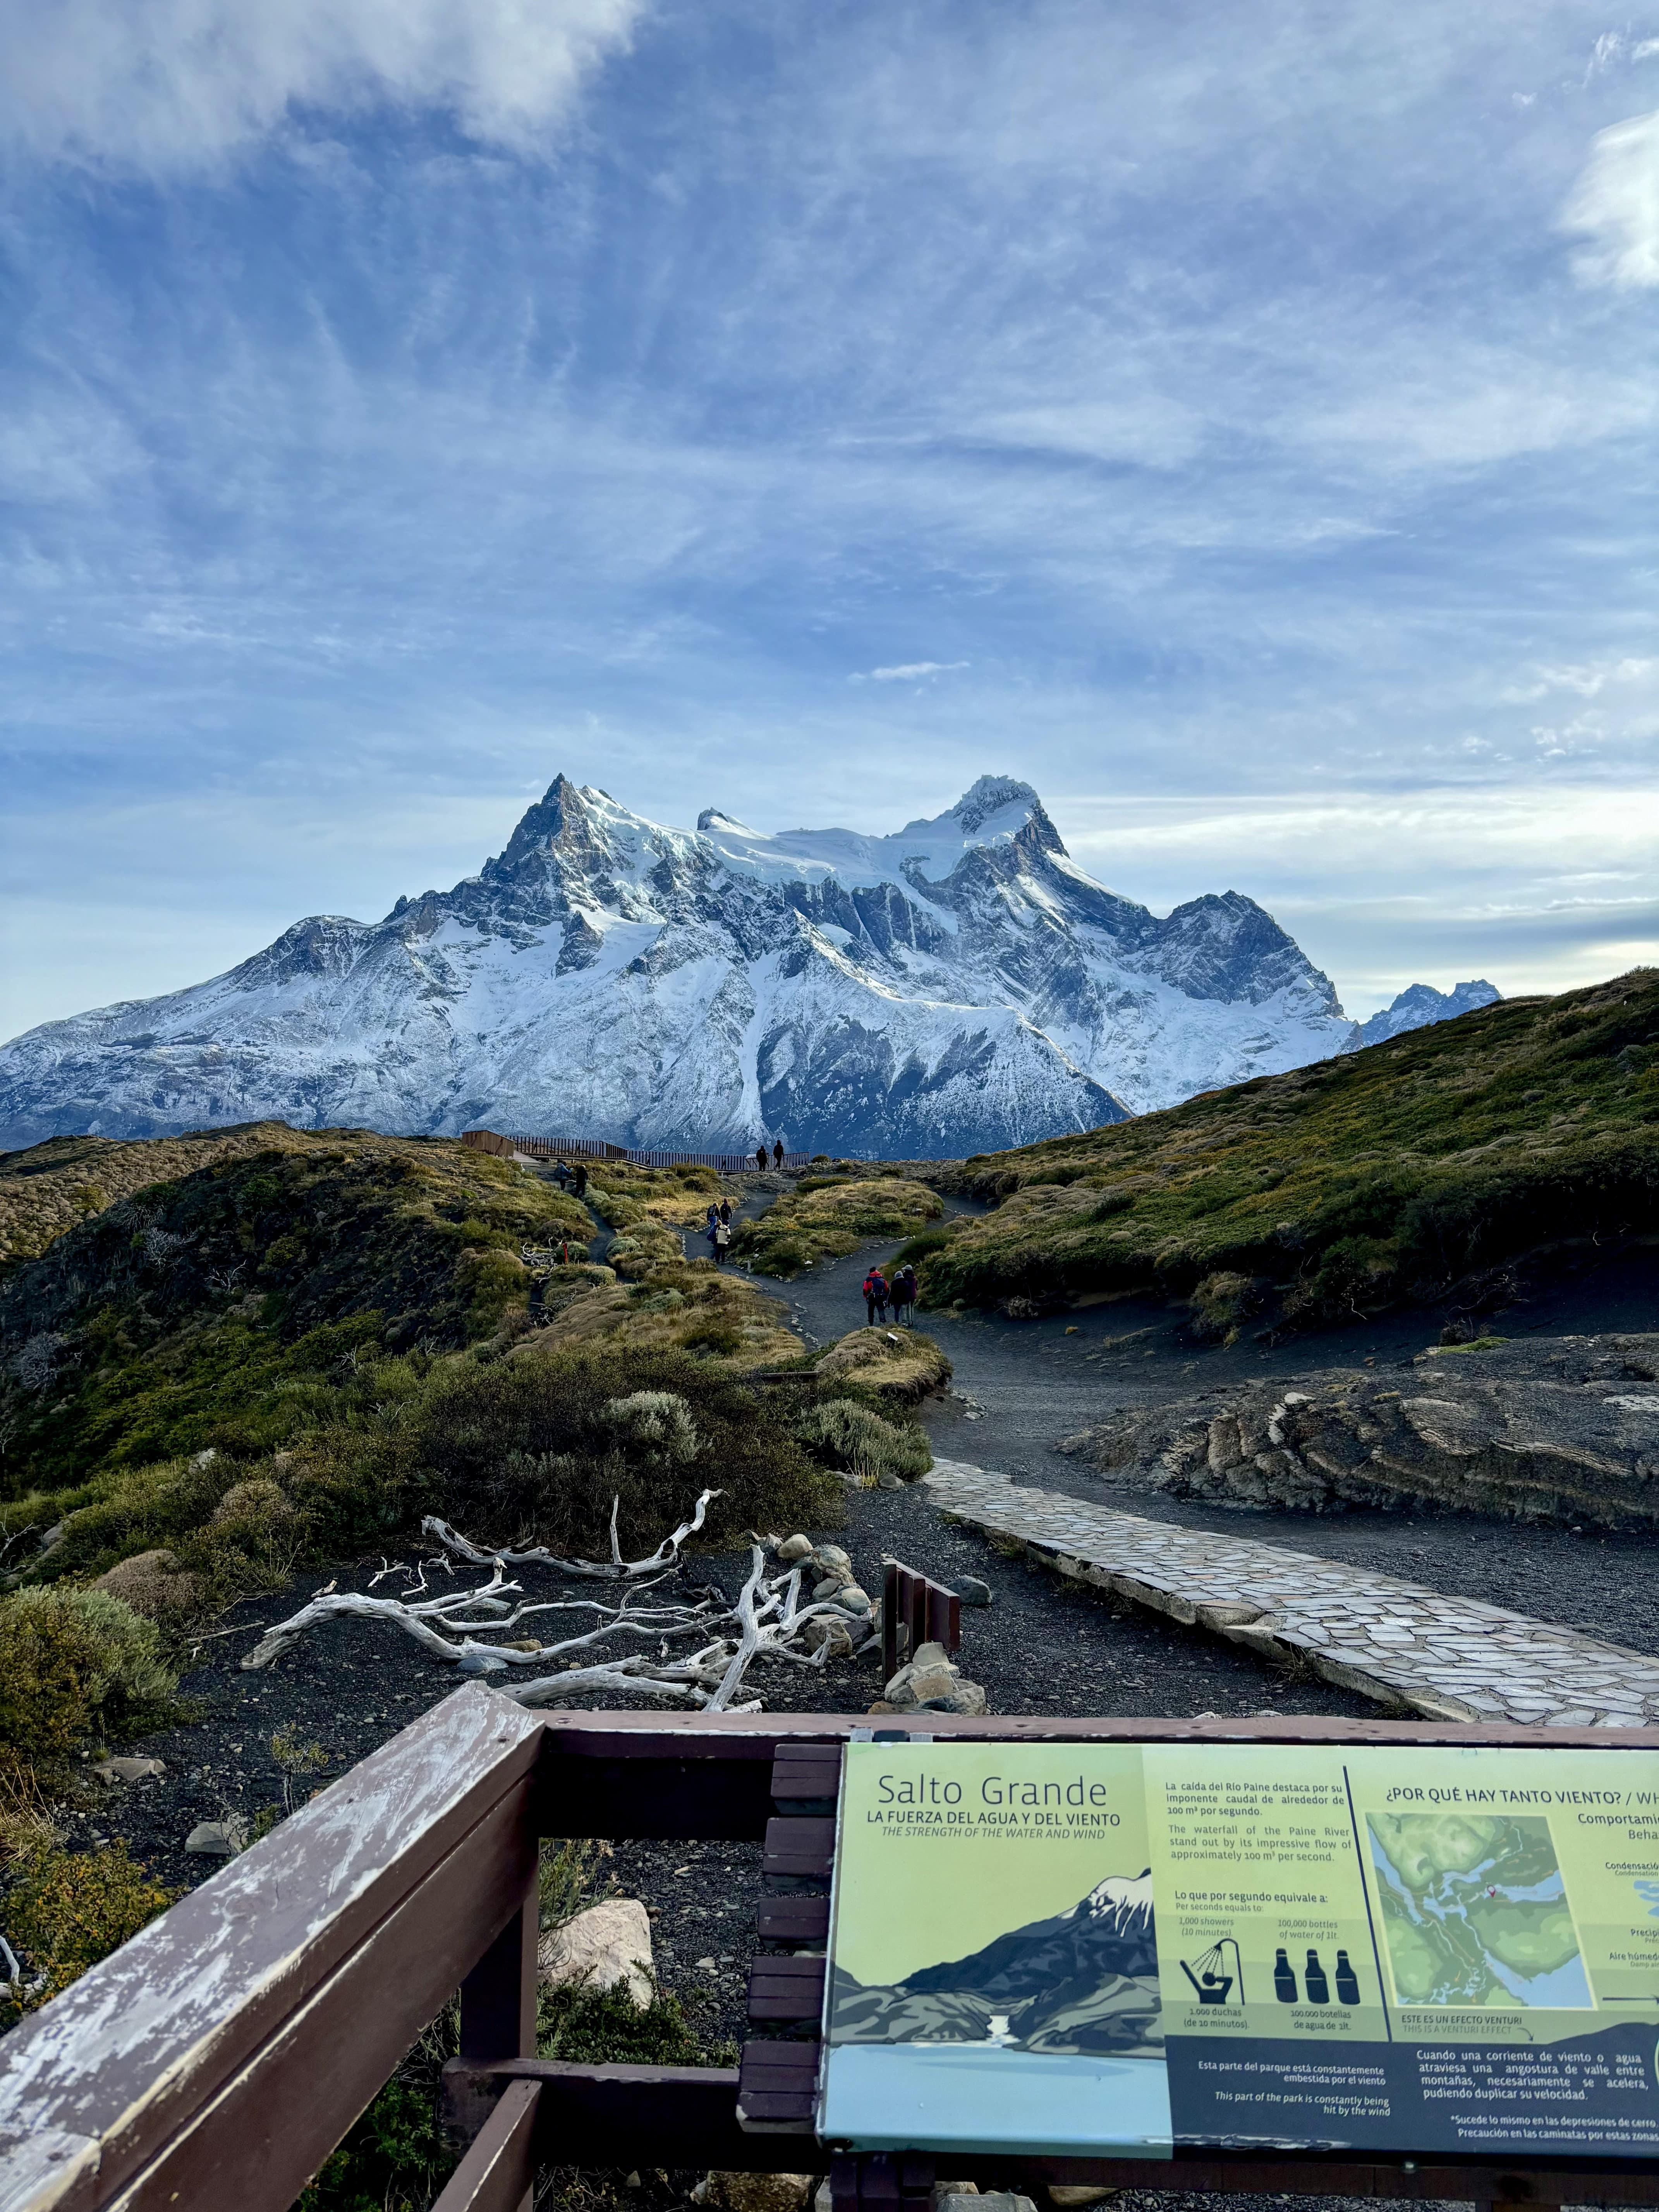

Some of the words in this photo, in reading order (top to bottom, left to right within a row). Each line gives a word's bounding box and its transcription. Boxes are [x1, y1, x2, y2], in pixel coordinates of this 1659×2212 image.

[879, 1774, 962, 1804] Salto
[982, 1776, 1106, 1806] Grande
[1181, 1782, 1206, 1790] caída
[1209, 1782, 1223, 1791] del
[1226, 1783, 1241, 1791] Río
[1244, 1783, 1269, 1791] Paine
[1273, 1783, 1310, 1792] destaca
[1313, 1785, 1328, 1794] por
[1167, 1794, 1218, 1804] imponente
[1226, 1795, 1257, 1803] caudal
[1262, 1795, 1273, 1803] de
[1333, 1796, 1344, 1805] de
[1387, 1788, 1425, 1801] ¿POR
[1429, 1788, 1462, 1803] QUÉ
[1466, 1790, 1495, 1802] HAY
[1499, 1790, 1551, 1803] TANTO
[1555, 1791, 1621, 1804] VIENTO?
[1201, 1808, 1216, 1817] por
[1219, 1807, 1262, 1817] segundo.
[868, 1811, 883, 1822] LA
[888, 1811, 943, 1823] FUERZA
[947, 1812, 974, 1824] DEL
[978, 1812, 1018, 1824] AGUA
[1022, 1813, 1030, 1824] Y
[1035, 1813, 1062, 1825] DEL
[1066, 1814, 1120, 1826] VIENTO
[1578, 1814, 1659, 1826] Comportami
[883, 1827, 903, 1836] THE
[905, 1827, 962, 1837] STRENGTH
[965, 1827, 979, 1837] OF
[982, 1828, 1003, 1837] THE
[1006, 1828, 1043, 1838] WATER
[1046, 1829, 1070, 1839] AND
[1074, 1829, 1105, 1839] WIND
[1169, 1824, 1185, 1833] The
[1194, 1825, 1237, 1834] waterfall
[1246, 1826, 1255, 1834] of
[1265, 1826, 1280, 1835] the
[1289, 1827, 1316, 1835] Paine
[1325, 1827, 1349, 1836] River
[1629, 1829, 1659, 1839] Beha
[1170, 1837, 1197, 1846] stand
[1202, 1838, 1219, 1846] out
[1223, 1838, 1235, 1849] by
[1240, 1838, 1252, 1847] its
[1257, 1838, 1310, 1850] impressive
[1315, 1839, 1336, 1849] flow
[1342, 1840, 1351, 1849] of
[1171, 1850, 1242, 1862] approximately
[1278, 1853, 1294, 1862] per
[1297, 1852, 1334, 1861] second.
[1175, 1890, 1186, 1899] Lo
[1189, 1893, 1207, 1901] que
[1210, 1893, 1226, 1902] por
[1229, 1892, 1271, 1903] segundo
[1274, 1893, 1317, 1904] equivale
[1225, 1903, 1251, 1912] equals
[1179, 1917, 1199, 1926] 1,000
[1200, 1917, 1234, 1926] showers
[1278, 1920, 1307, 1929] 100,000
[1309, 1920, 1338, 1929] bottles
[1212, 2008, 1242, 2016] duchas
[1320, 2010, 1351, 2018] botellas
[1184, 2018, 1197, 2027] (de
[1210, 2019, 1249, 2030] minutos).
[1294, 2020, 1304, 2028] de
[1305, 2022, 1325, 2031] agua
[1326, 2021, 1336, 2030] de
[1402, 2015, 1421, 2023] ESTE
[1424, 2015, 1433, 2023] ES
[1451, 2016, 1482, 2024] EFECTO
[1424, 2025, 1432, 2033] IS
[1441, 2025, 1478, 2033] VENTURI
[1481, 2026, 1511, 2034] EFFECT
[1417, 2050, 1456, 2060] Cuando
[1486, 2051, 1534, 2061] corriente
[1540, 2051, 1552, 2062] de
[1558, 2052, 1591, 2062] viento
[1616, 2055, 1642, 2064] agua
[1199, 2061, 1218, 2069] Esta
[1219, 2063, 1242, 2071] parte
[1244, 2062, 1257, 2071] del
[1260, 2064, 1291, 2073] parque
[1293, 2064, 1311, 2073] está
[1313, 2066, 1384, 2075] constantemente
[1419, 2063, 1466, 2073] atraviesa
[1473, 2065, 1492, 2073] una
[1506, 2064, 1559, 2076] angostura
[1565, 2064, 1578, 2074] de
[1584, 2064, 1609, 2075] valle
[1616, 2066, 1644, 2076] entre
[1284, 2073, 1330, 2083] embestida
[1331, 2076, 1346, 2085] por
[1348, 2076, 1356, 2084] el
[1358, 2076, 1386, 2085] viento
[1421, 2075, 1475, 2087] montañas,
[1487, 2076, 1570, 2087] necesariamente
[1583, 2079, 1594, 2087] se
[1607, 2078, 1649, 2090] acelera,
[1216, 2091, 1233, 2100] This
[1235, 2093, 1253, 2102] part
[1255, 2092, 1264, 2101] of
[1267, 2093, 1281, 2102] the
[1283, 2094, 1303, 2104] park
[1305, 2094, 1312, 2103] is
[1314, 2096, 1362, 2107] constantly
[1364, 2096, 1389, 2108] being
[1424, 2087, 1472, 2100] pudiendo
[1475, 2088, 1517, 2100] duplicar
[1520, 2090, 1532, 2099] su
[1534, 2089, 1588, 2100] velocidad.
[1324, 2105, 1336, 2114] hit
[1338, 2106, 1350, 2117] by
[1352, 2106, 1366, 2115] the
[1369, 2107, 1390, 2116] wind
[1489, 2115, 1498, 2124] lo
[1500, 2115, 1530, 2125] mismo
[1545, 2116, 1559, 2126] las
[1560, 2116, 1616, 2128] depresiones
[1618, 2118, 1630, 2127] de
[1458, 2128, 1509, 2138] Precaución
[1523, 2128, 1537, 2138] las
[1539, 2129, 1587, 2139] caminatas
[1588, 2132, 1603, 2141] por
[1606, 2131, 1631, 2140] estas
